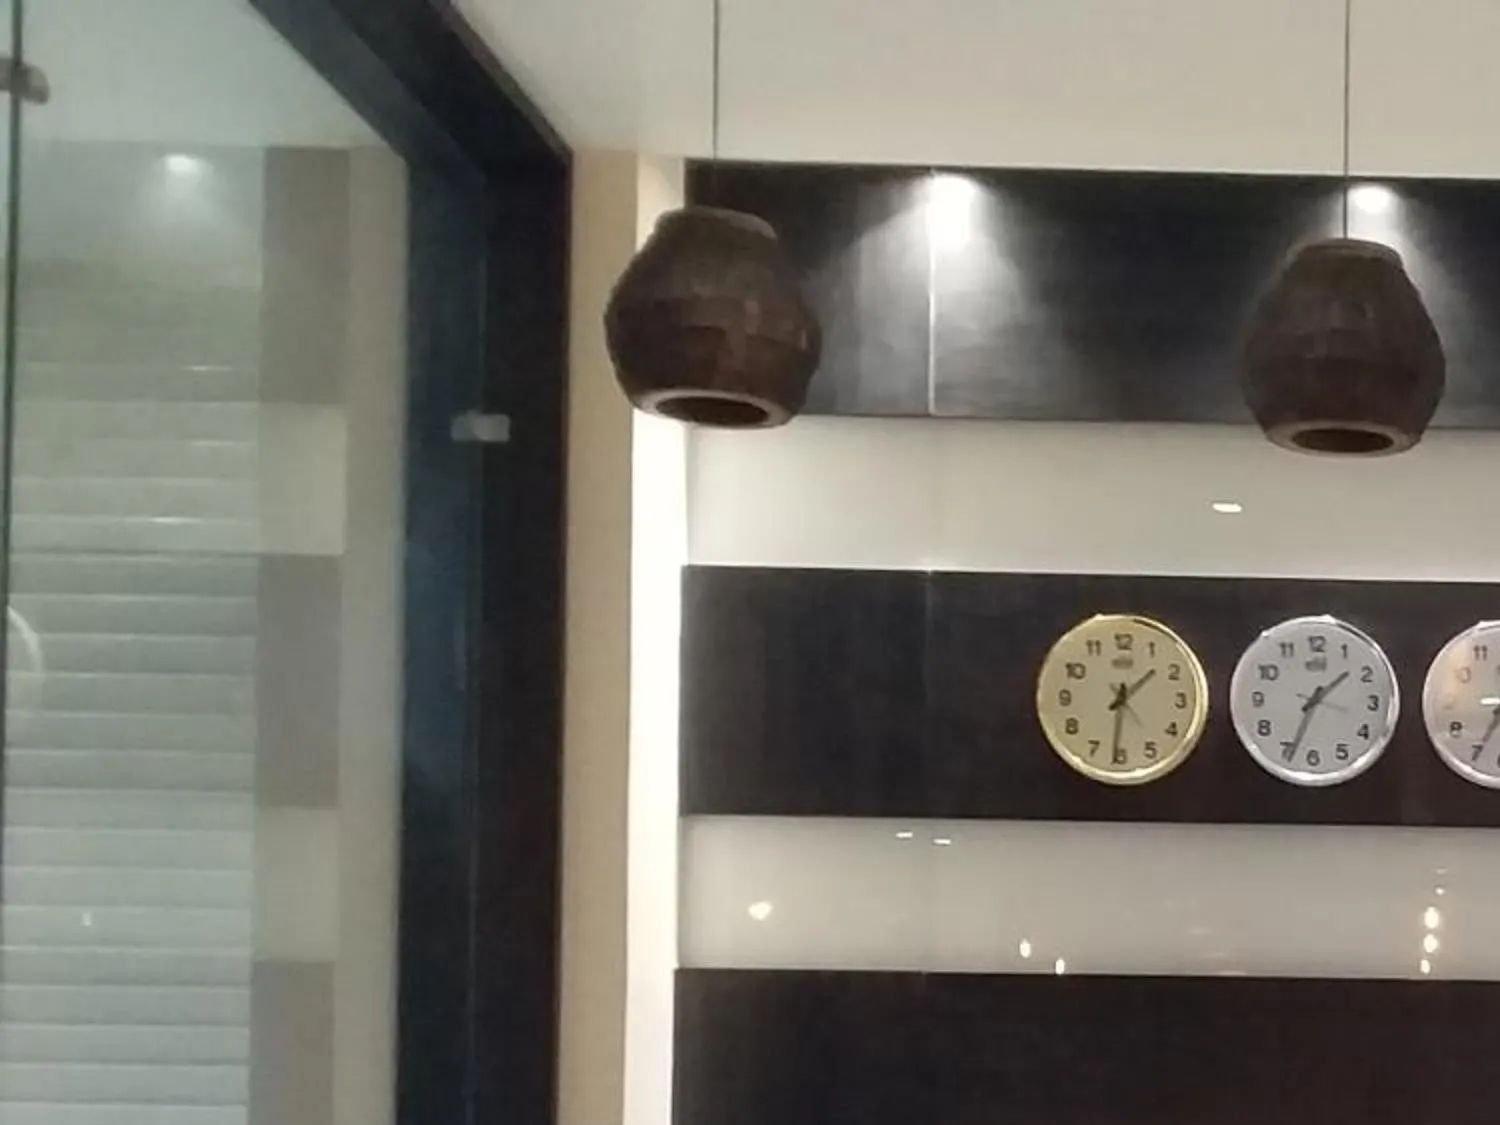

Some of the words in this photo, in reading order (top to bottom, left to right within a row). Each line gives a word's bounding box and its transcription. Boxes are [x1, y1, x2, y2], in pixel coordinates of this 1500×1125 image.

[1085, 640, 1102, 656] 11
[1115, 633, 1134, 650] 12
[1148, 642, 1155, 657] 1
[1280, 642, 1294, 657] 11
[1308, 636, 1326, 652] 12
[1341, 644, 1348, 659] 1
[1474, 645, 1487, 660] 11
[1066, 662, 1086, 679] 10
[1168, 664, 1180, 680] 2
[1258, 664, 1279, 681] 10
[1360, 666, 1373, 682] 2
[1059, 689, 1072, 706] 9
[1175, 692, 1187, 709] 3
[1252, 691, 1264, 708] 9
[1367, 695, 1379, 711] 3
[1065, 718, 1079, 735] 8
[1165, 722, 1178, 736] 4
[1258, 720, 1271, 736] 8
[1357, 723, 1369, 739] 4
[1088, 740, 1100, 756] 7
[1145, 741, 1157, 758] 5
[1336, 743, 1349, 760] 5
[1472, 744, 1484, 761] 7
[1307, 750, 1320, 766] 6
